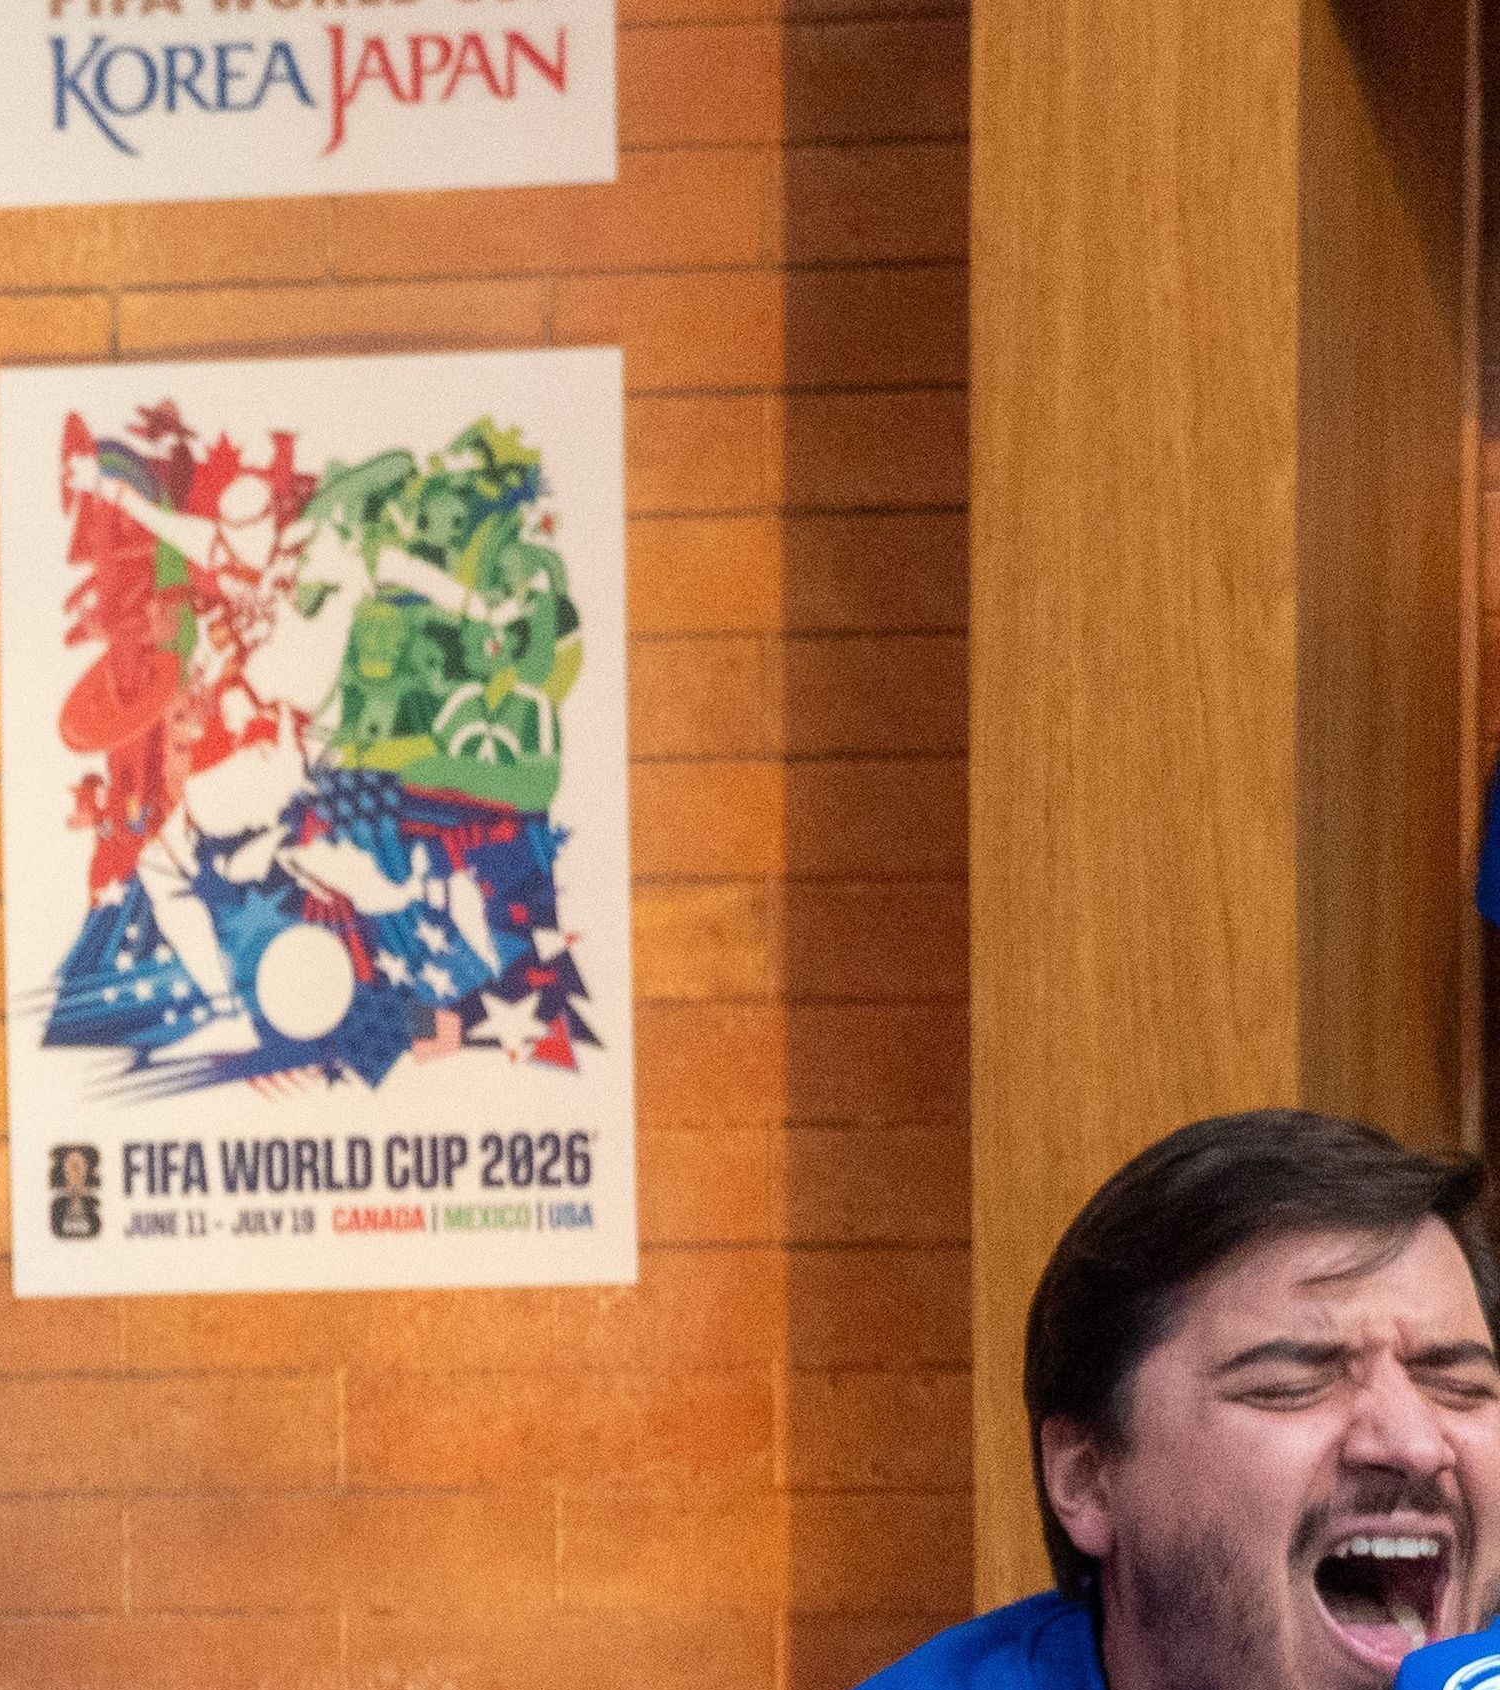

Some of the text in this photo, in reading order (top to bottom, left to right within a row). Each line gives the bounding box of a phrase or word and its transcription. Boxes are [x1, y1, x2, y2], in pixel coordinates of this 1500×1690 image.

[122, 1130, 591, 1196] FIFA WORLD CUP 2026
[232, 1208, 283, 1235] JULY
[332, 1204, 425, 1234] CANADA
[443, 1202, 532, 1231] MEXICO
[549, 1200, 593, 1228] USA
